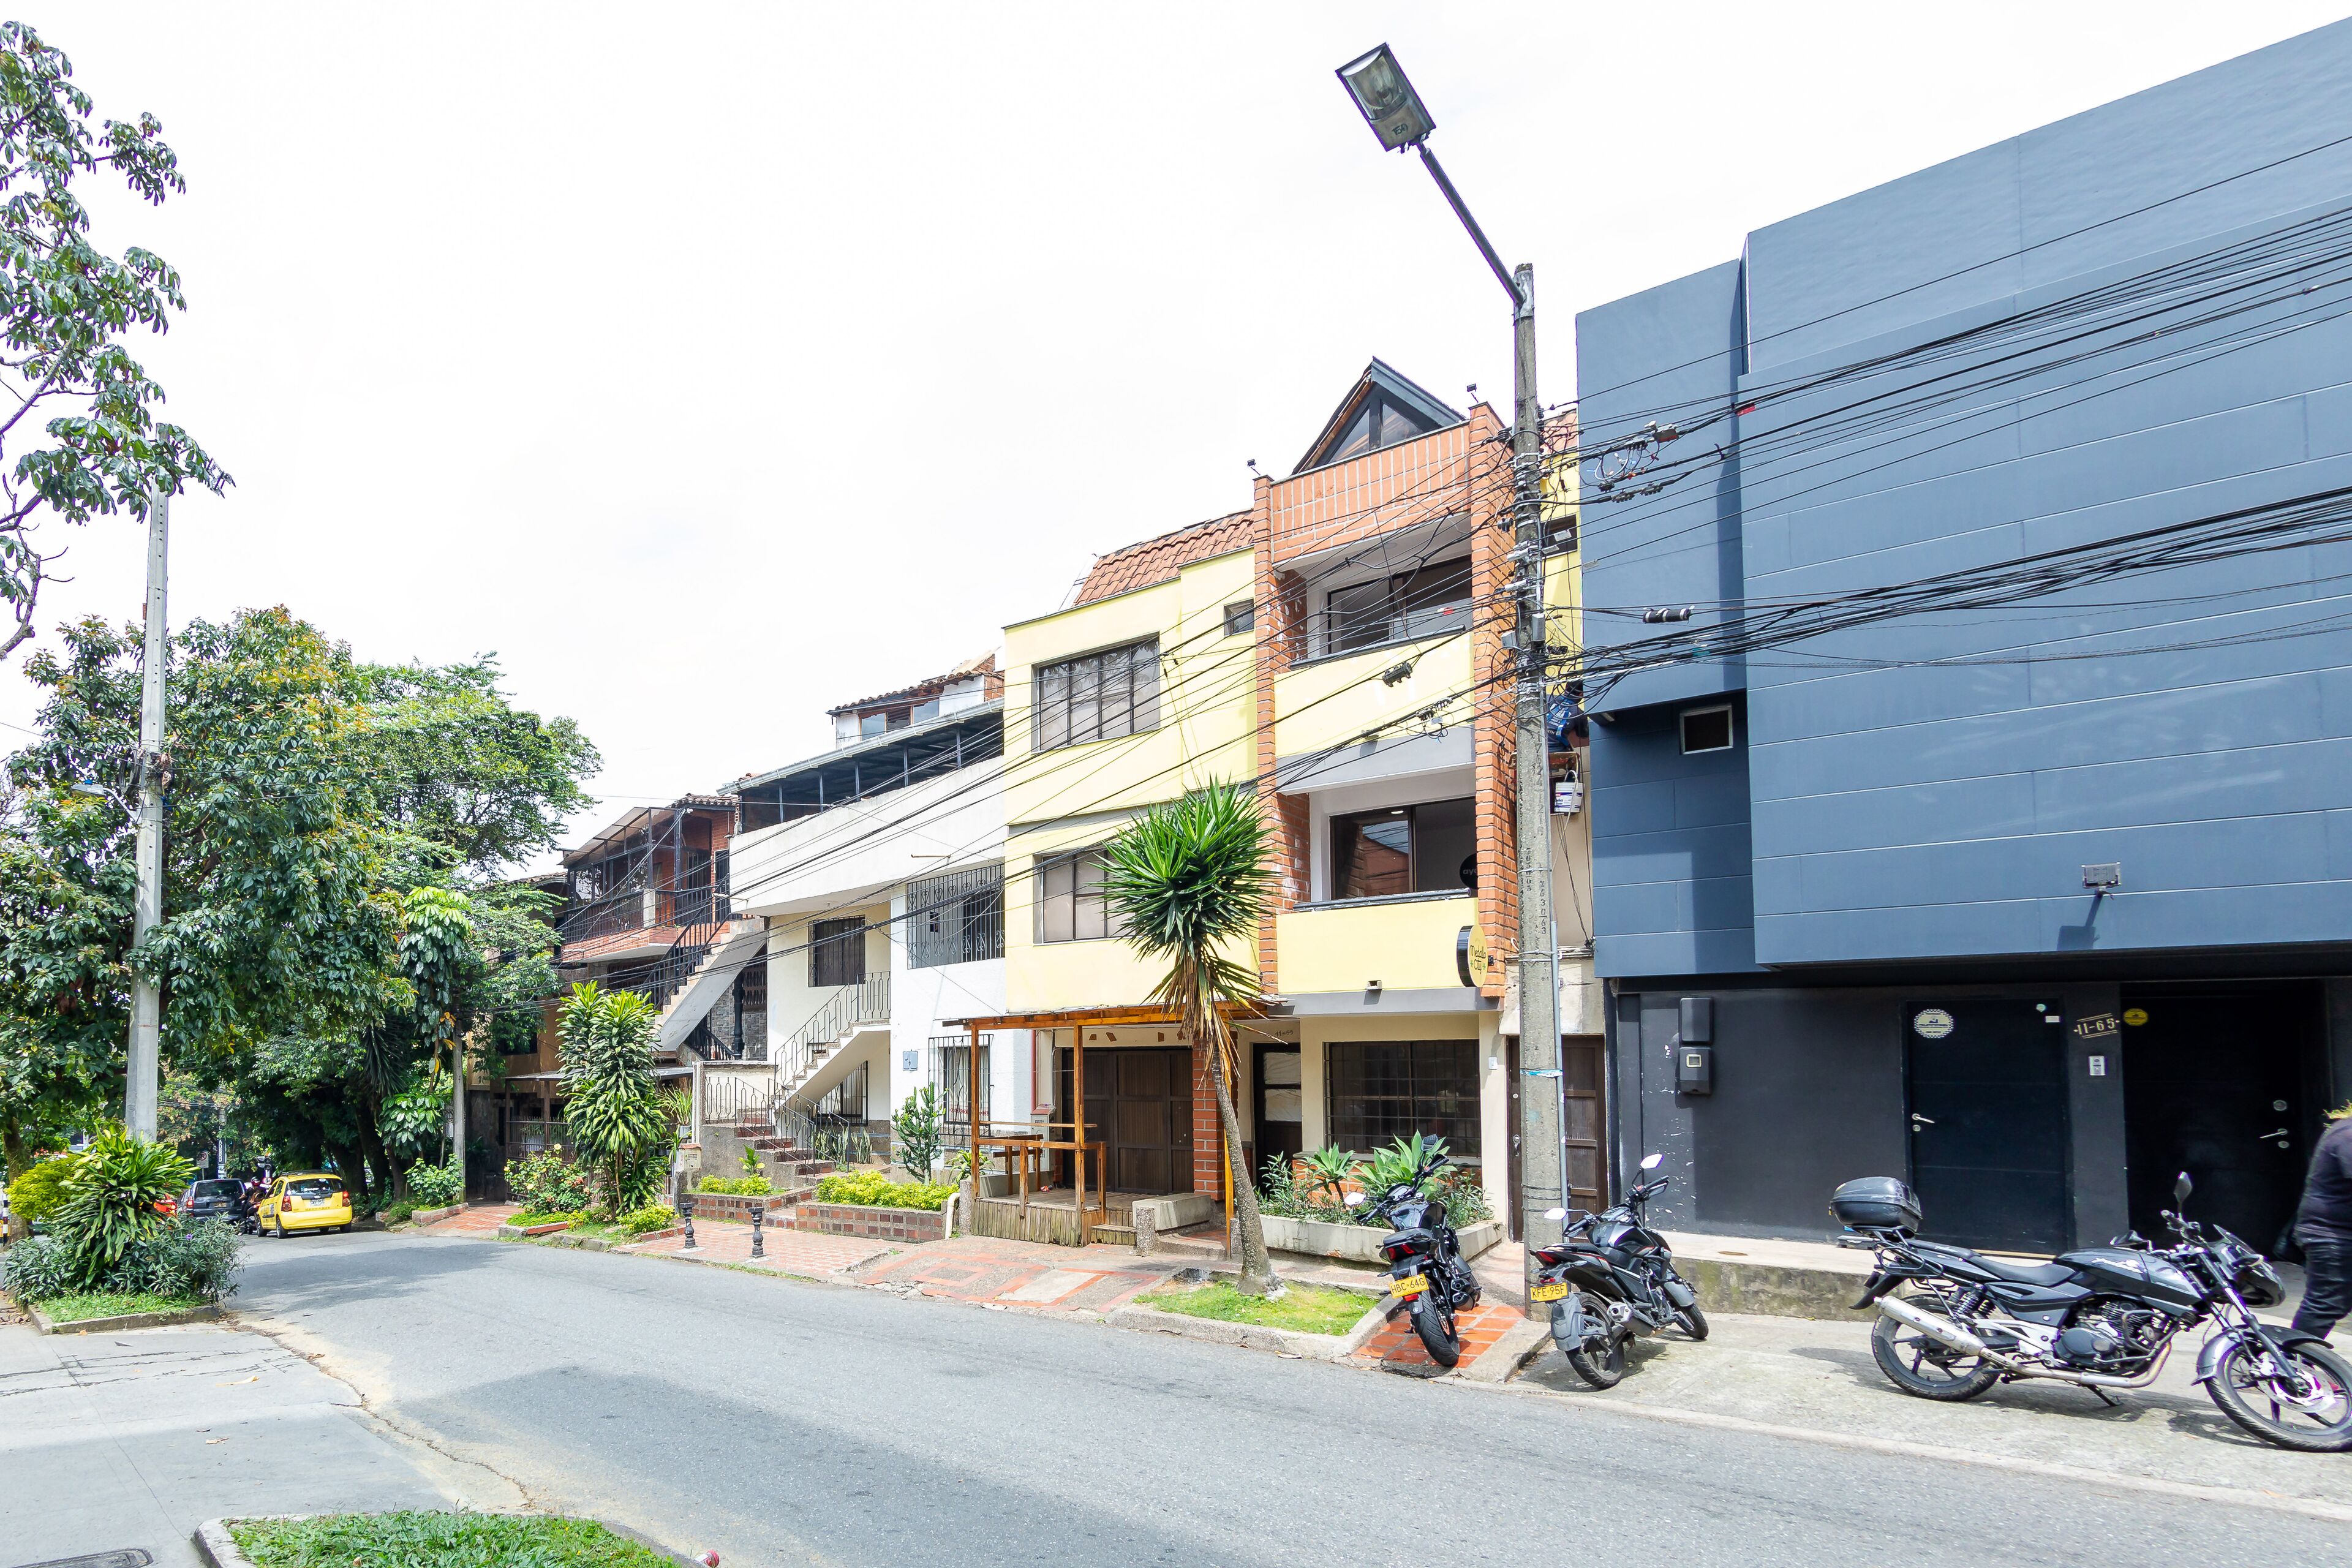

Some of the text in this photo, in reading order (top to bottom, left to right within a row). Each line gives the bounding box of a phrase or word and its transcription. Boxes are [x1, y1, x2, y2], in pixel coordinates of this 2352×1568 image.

[1390, 1283, 1407, 1294] HBC
[1410, 1278, 1425, 1289] 64G
[1532, 1284, 1565, 1298] KFE 95F
